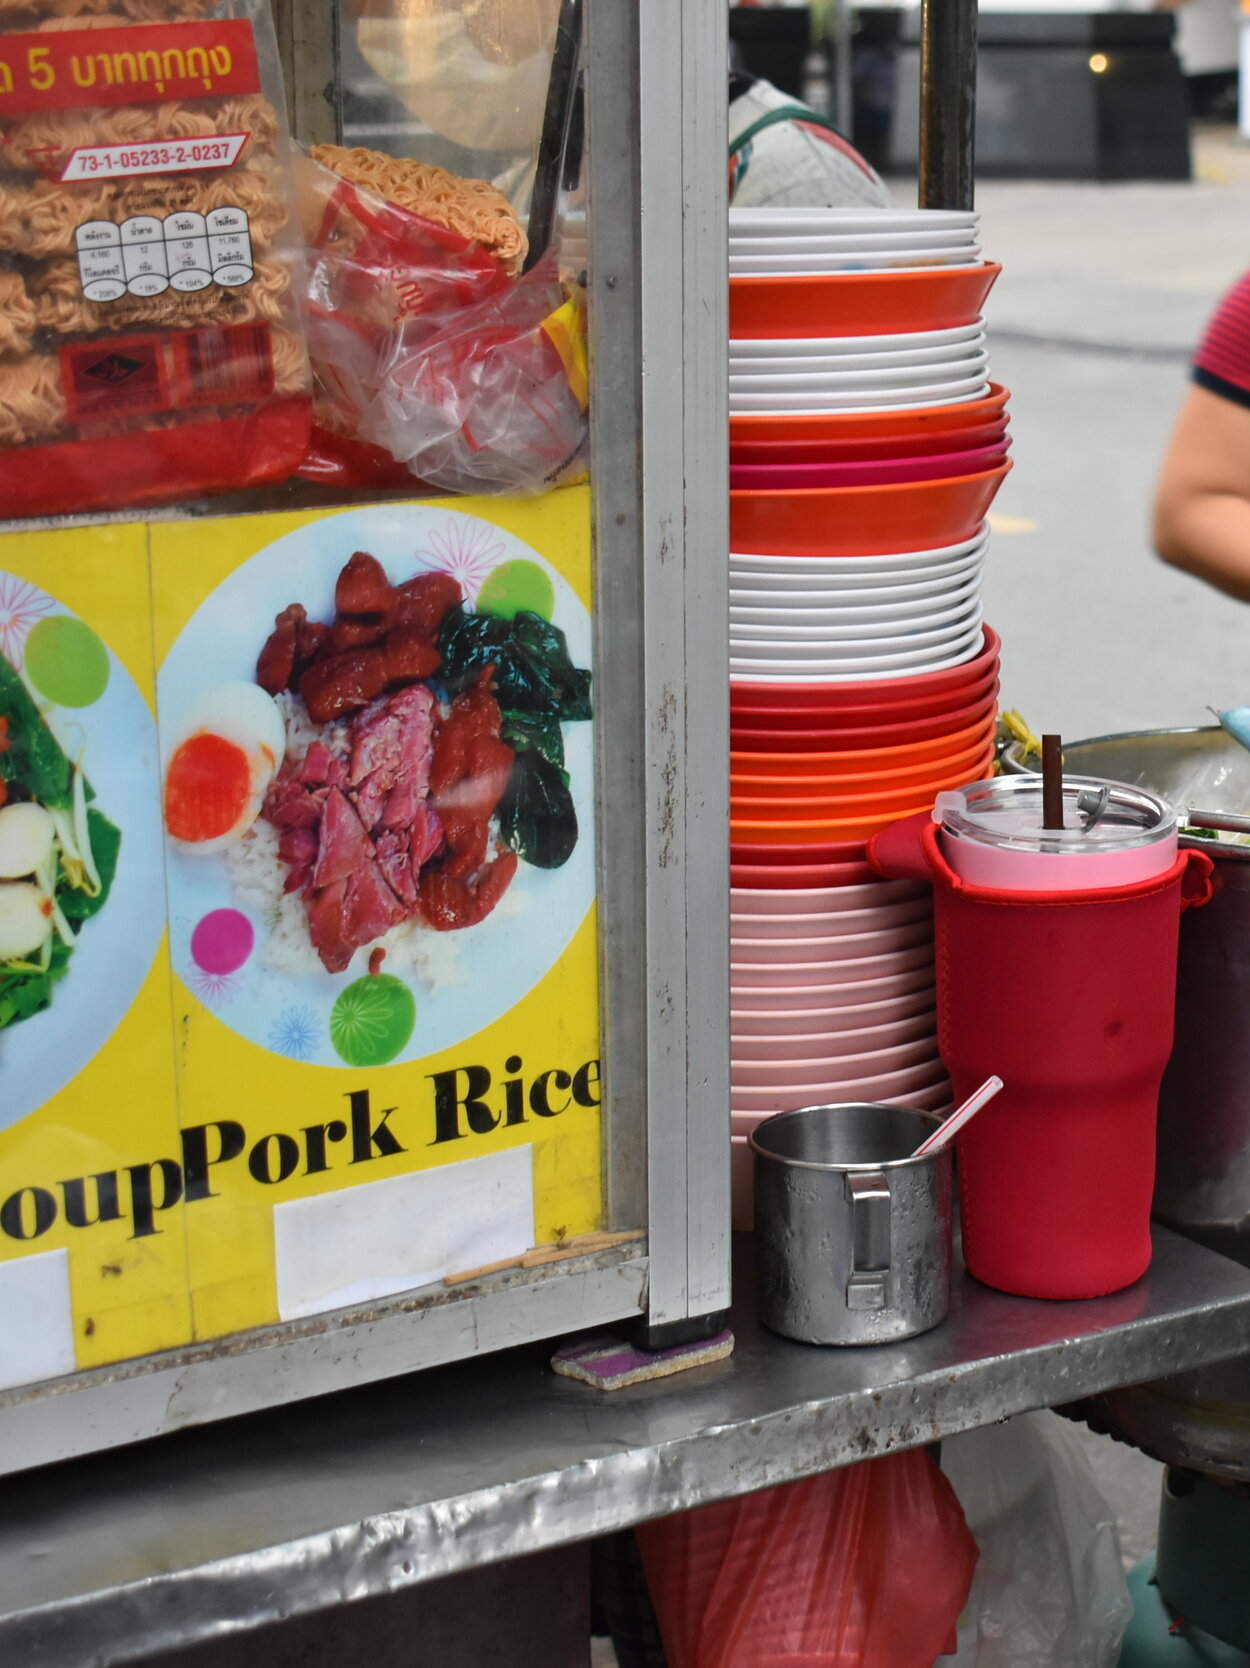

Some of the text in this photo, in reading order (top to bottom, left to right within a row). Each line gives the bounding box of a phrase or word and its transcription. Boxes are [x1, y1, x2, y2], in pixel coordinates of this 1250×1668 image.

[27, 47, 56, 90] 5
[70, 45, 233, 94] บาททุกถุง
[78, 143, 231, 172] 73-1-05233-2-0237
[424, 1055, 601, 1147] Rice
